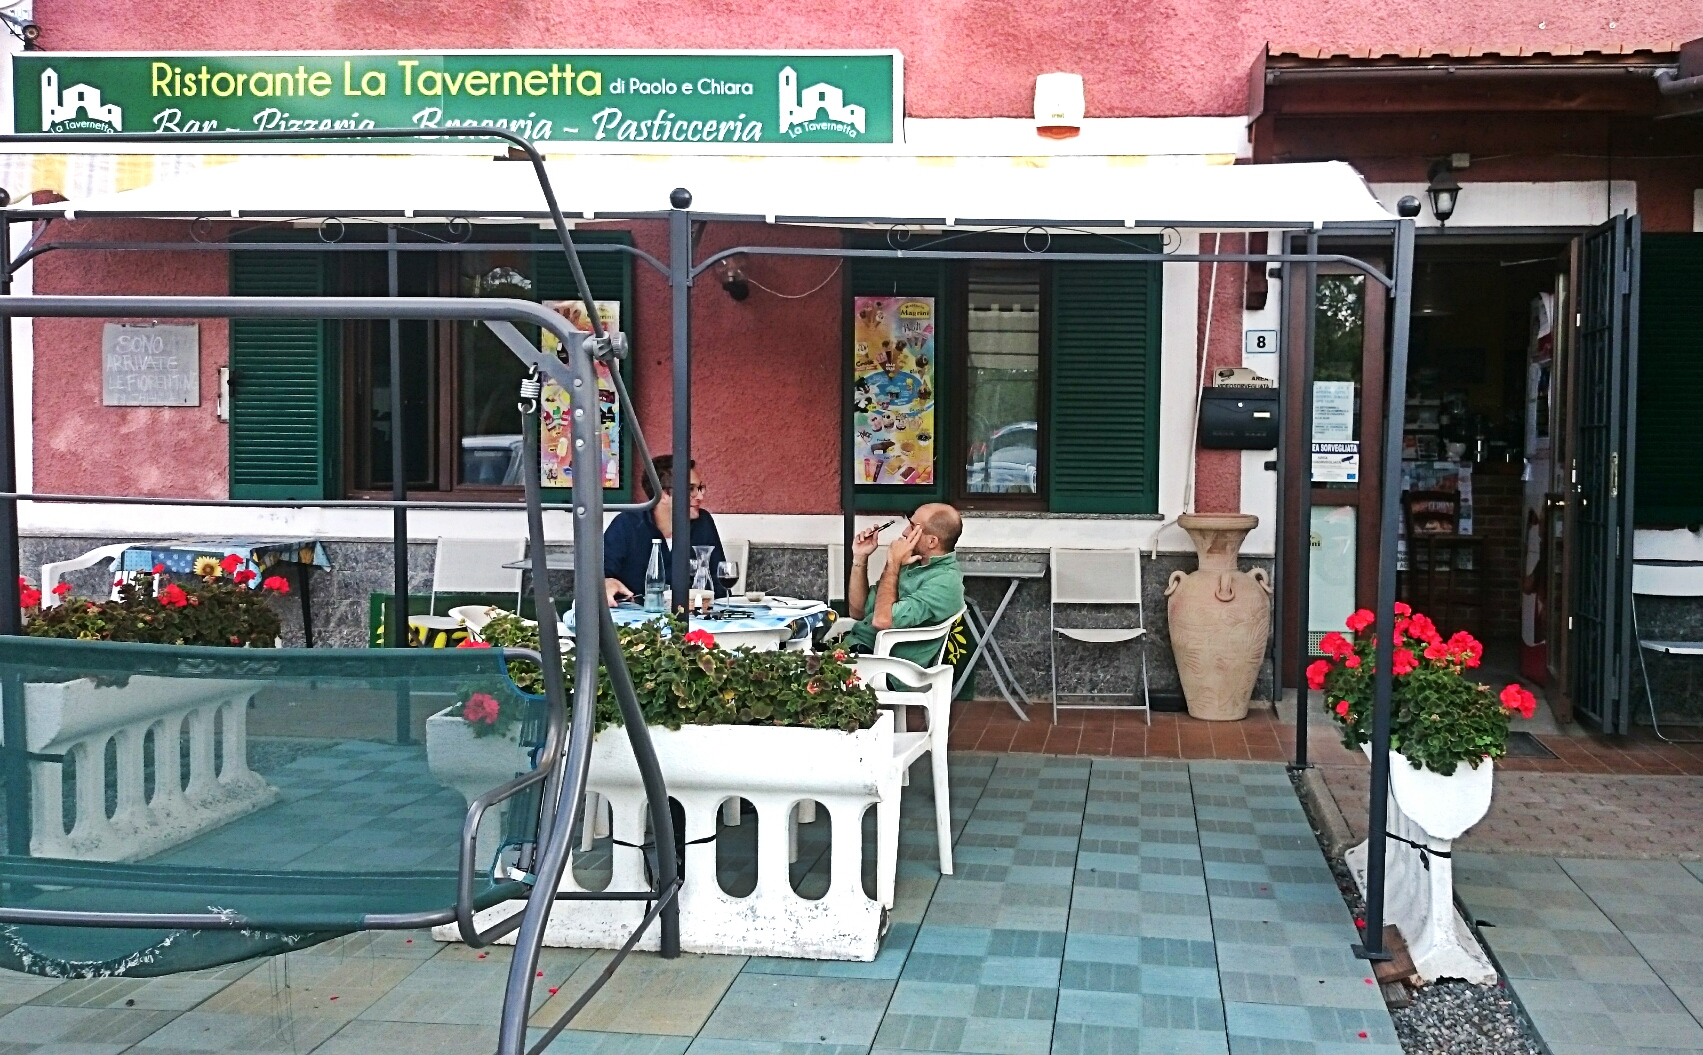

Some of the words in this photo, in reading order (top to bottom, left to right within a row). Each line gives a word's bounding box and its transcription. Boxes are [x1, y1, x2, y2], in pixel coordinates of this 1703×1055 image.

[152, 62, 333, 97] Ristorante
[344, 61, 386, 97] La
[398, 60, 602, 97] Tavernetta
[609, 78, 625, 95] di
[630, 78, 677, 95] Paolo
[681, 81, 693, 95] e
[697, 78, 753, 95] Chiara
[64, 121, 114, 134] Tavernetta
[153, 108, 217, 133] Bar
[592, 107, 763, 142] Pasticceria
[788, 127, 802, 139] La
[803, 122, 857, 138] Tavernetta
[900, 309, 930, 317] Magrini
[116, 334, 164, 354] SONO
[1256, 335, 1267, 349] 8
[106, 353, 179, 372] ARRIVATE
[1312, 443, 1320, 452] EA
[1320, 443, 1358, 453] SORVEGLIATA
